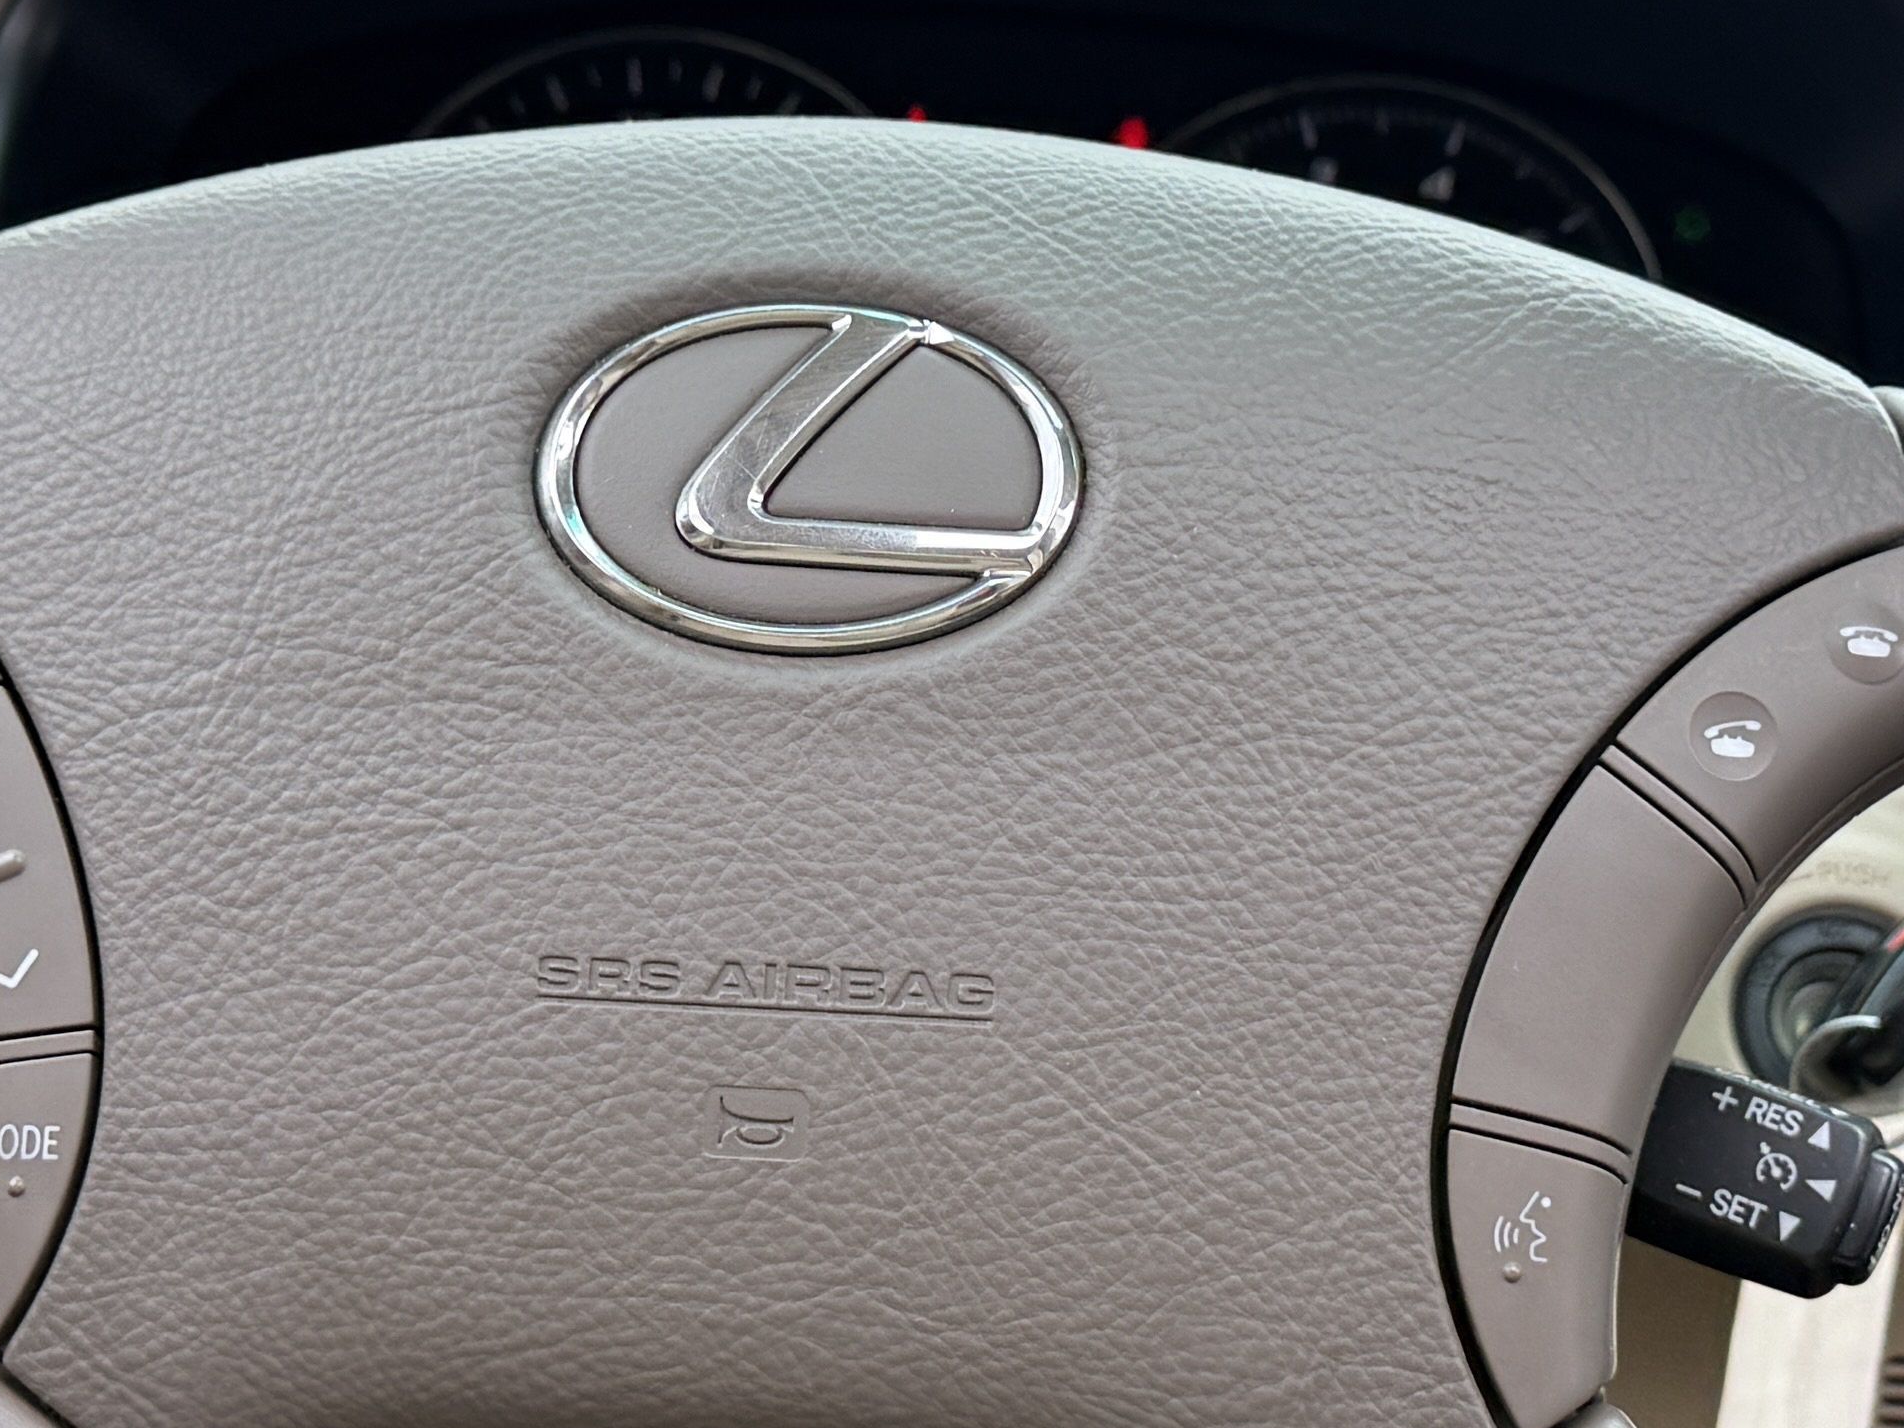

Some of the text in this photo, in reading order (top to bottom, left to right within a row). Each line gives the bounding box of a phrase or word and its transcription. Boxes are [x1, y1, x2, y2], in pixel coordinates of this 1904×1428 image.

[537, 955, 996, 1016] SRS AIRBAG
[1744, 1096, 1805, 1137] RES
[1709, 1188, 1768, 1230] SET
